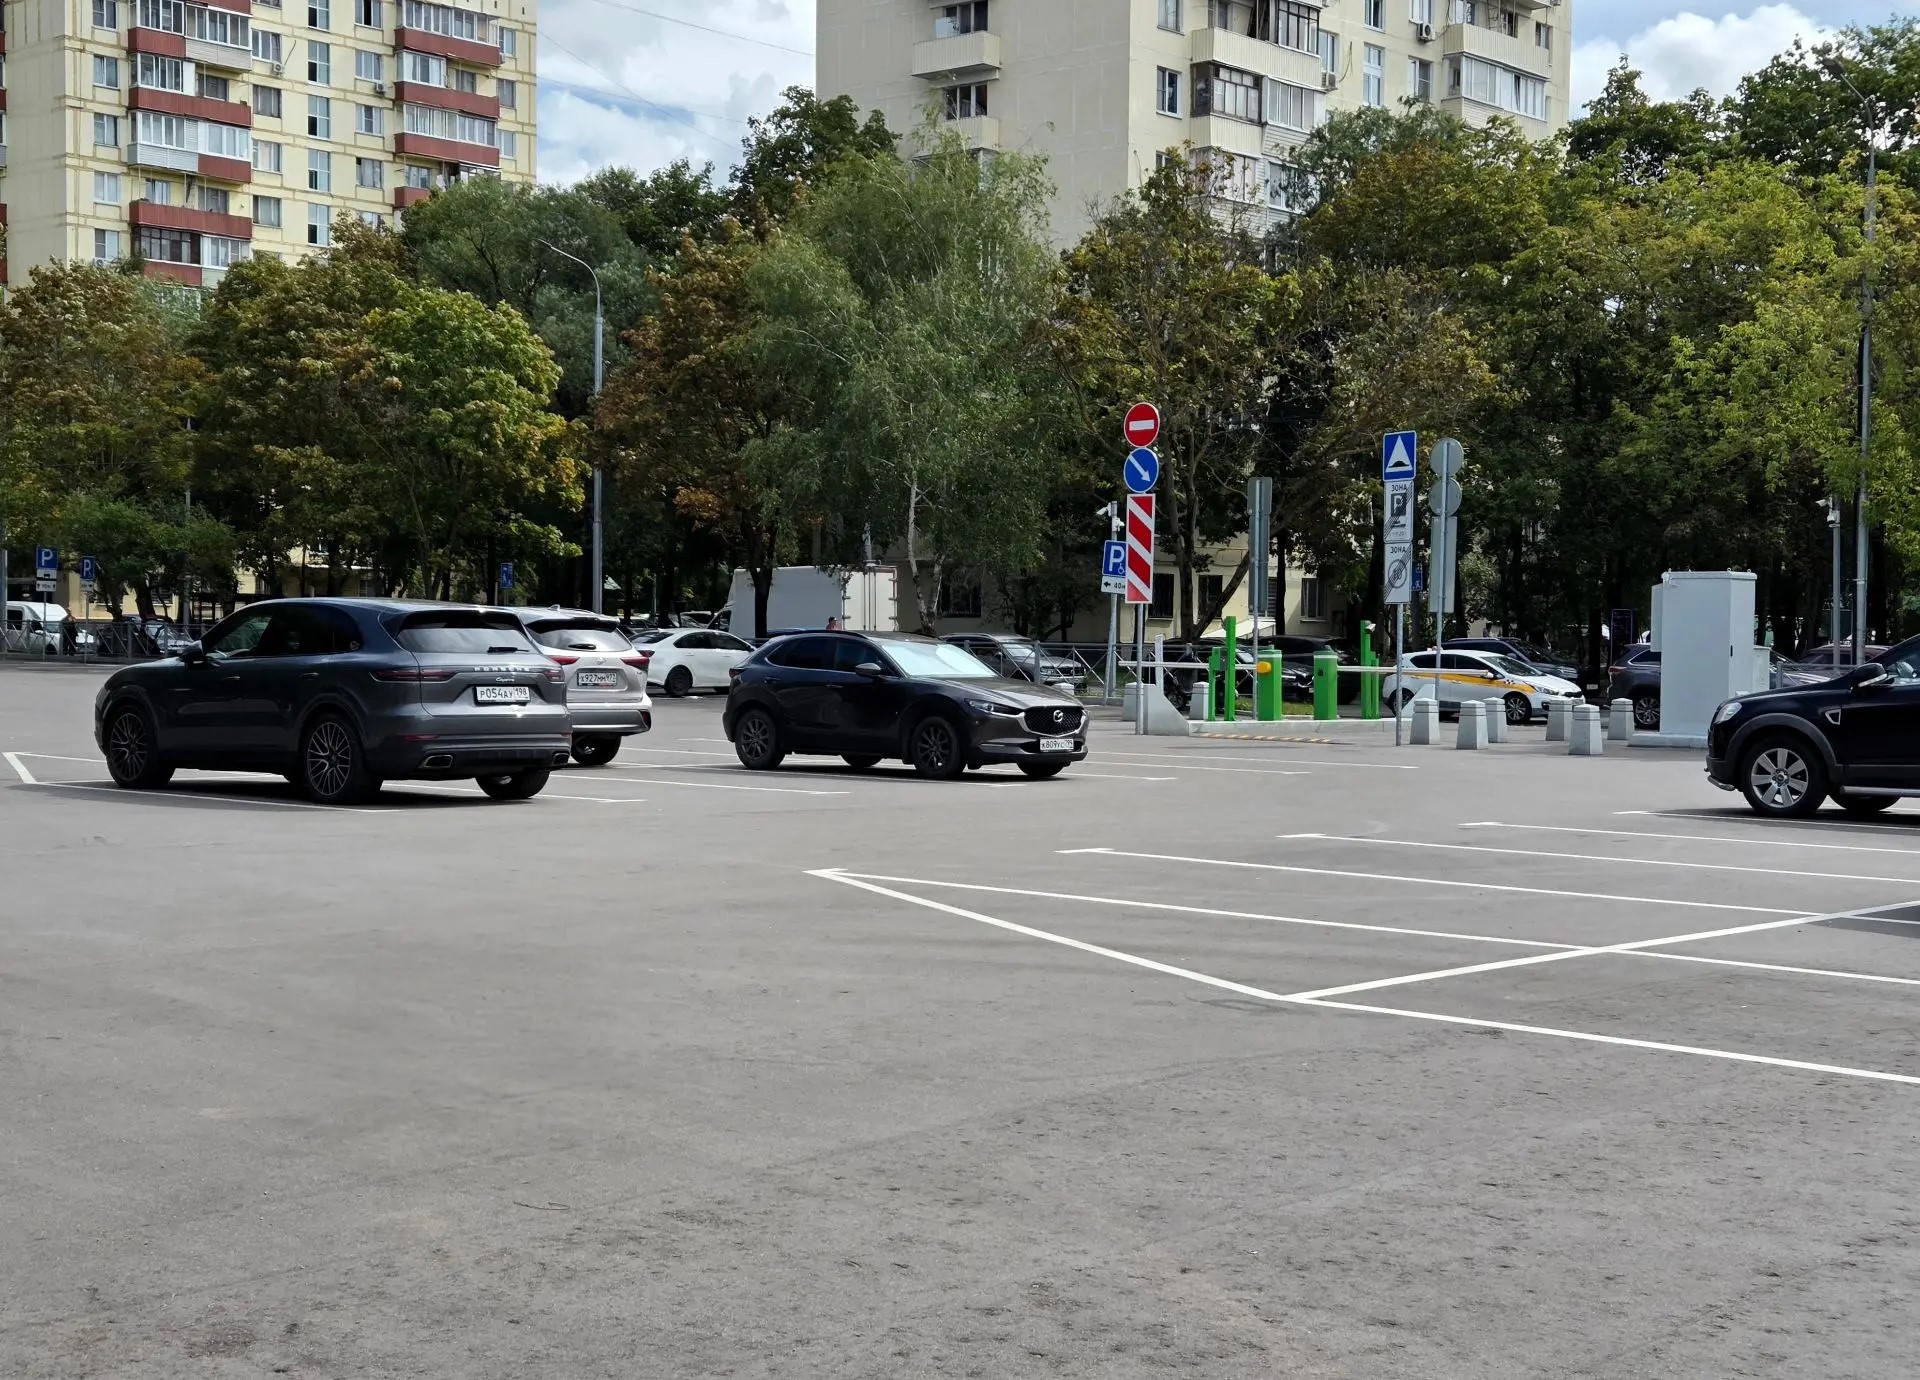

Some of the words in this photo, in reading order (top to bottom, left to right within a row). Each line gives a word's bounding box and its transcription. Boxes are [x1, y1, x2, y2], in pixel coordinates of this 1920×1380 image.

[1391, 484, 1408, 492] ЗОНА
[1390, 546, 1407, 554] ЗОНА
[41, 548, 53, 566] P
[1108, 545, 1125, 572] P
